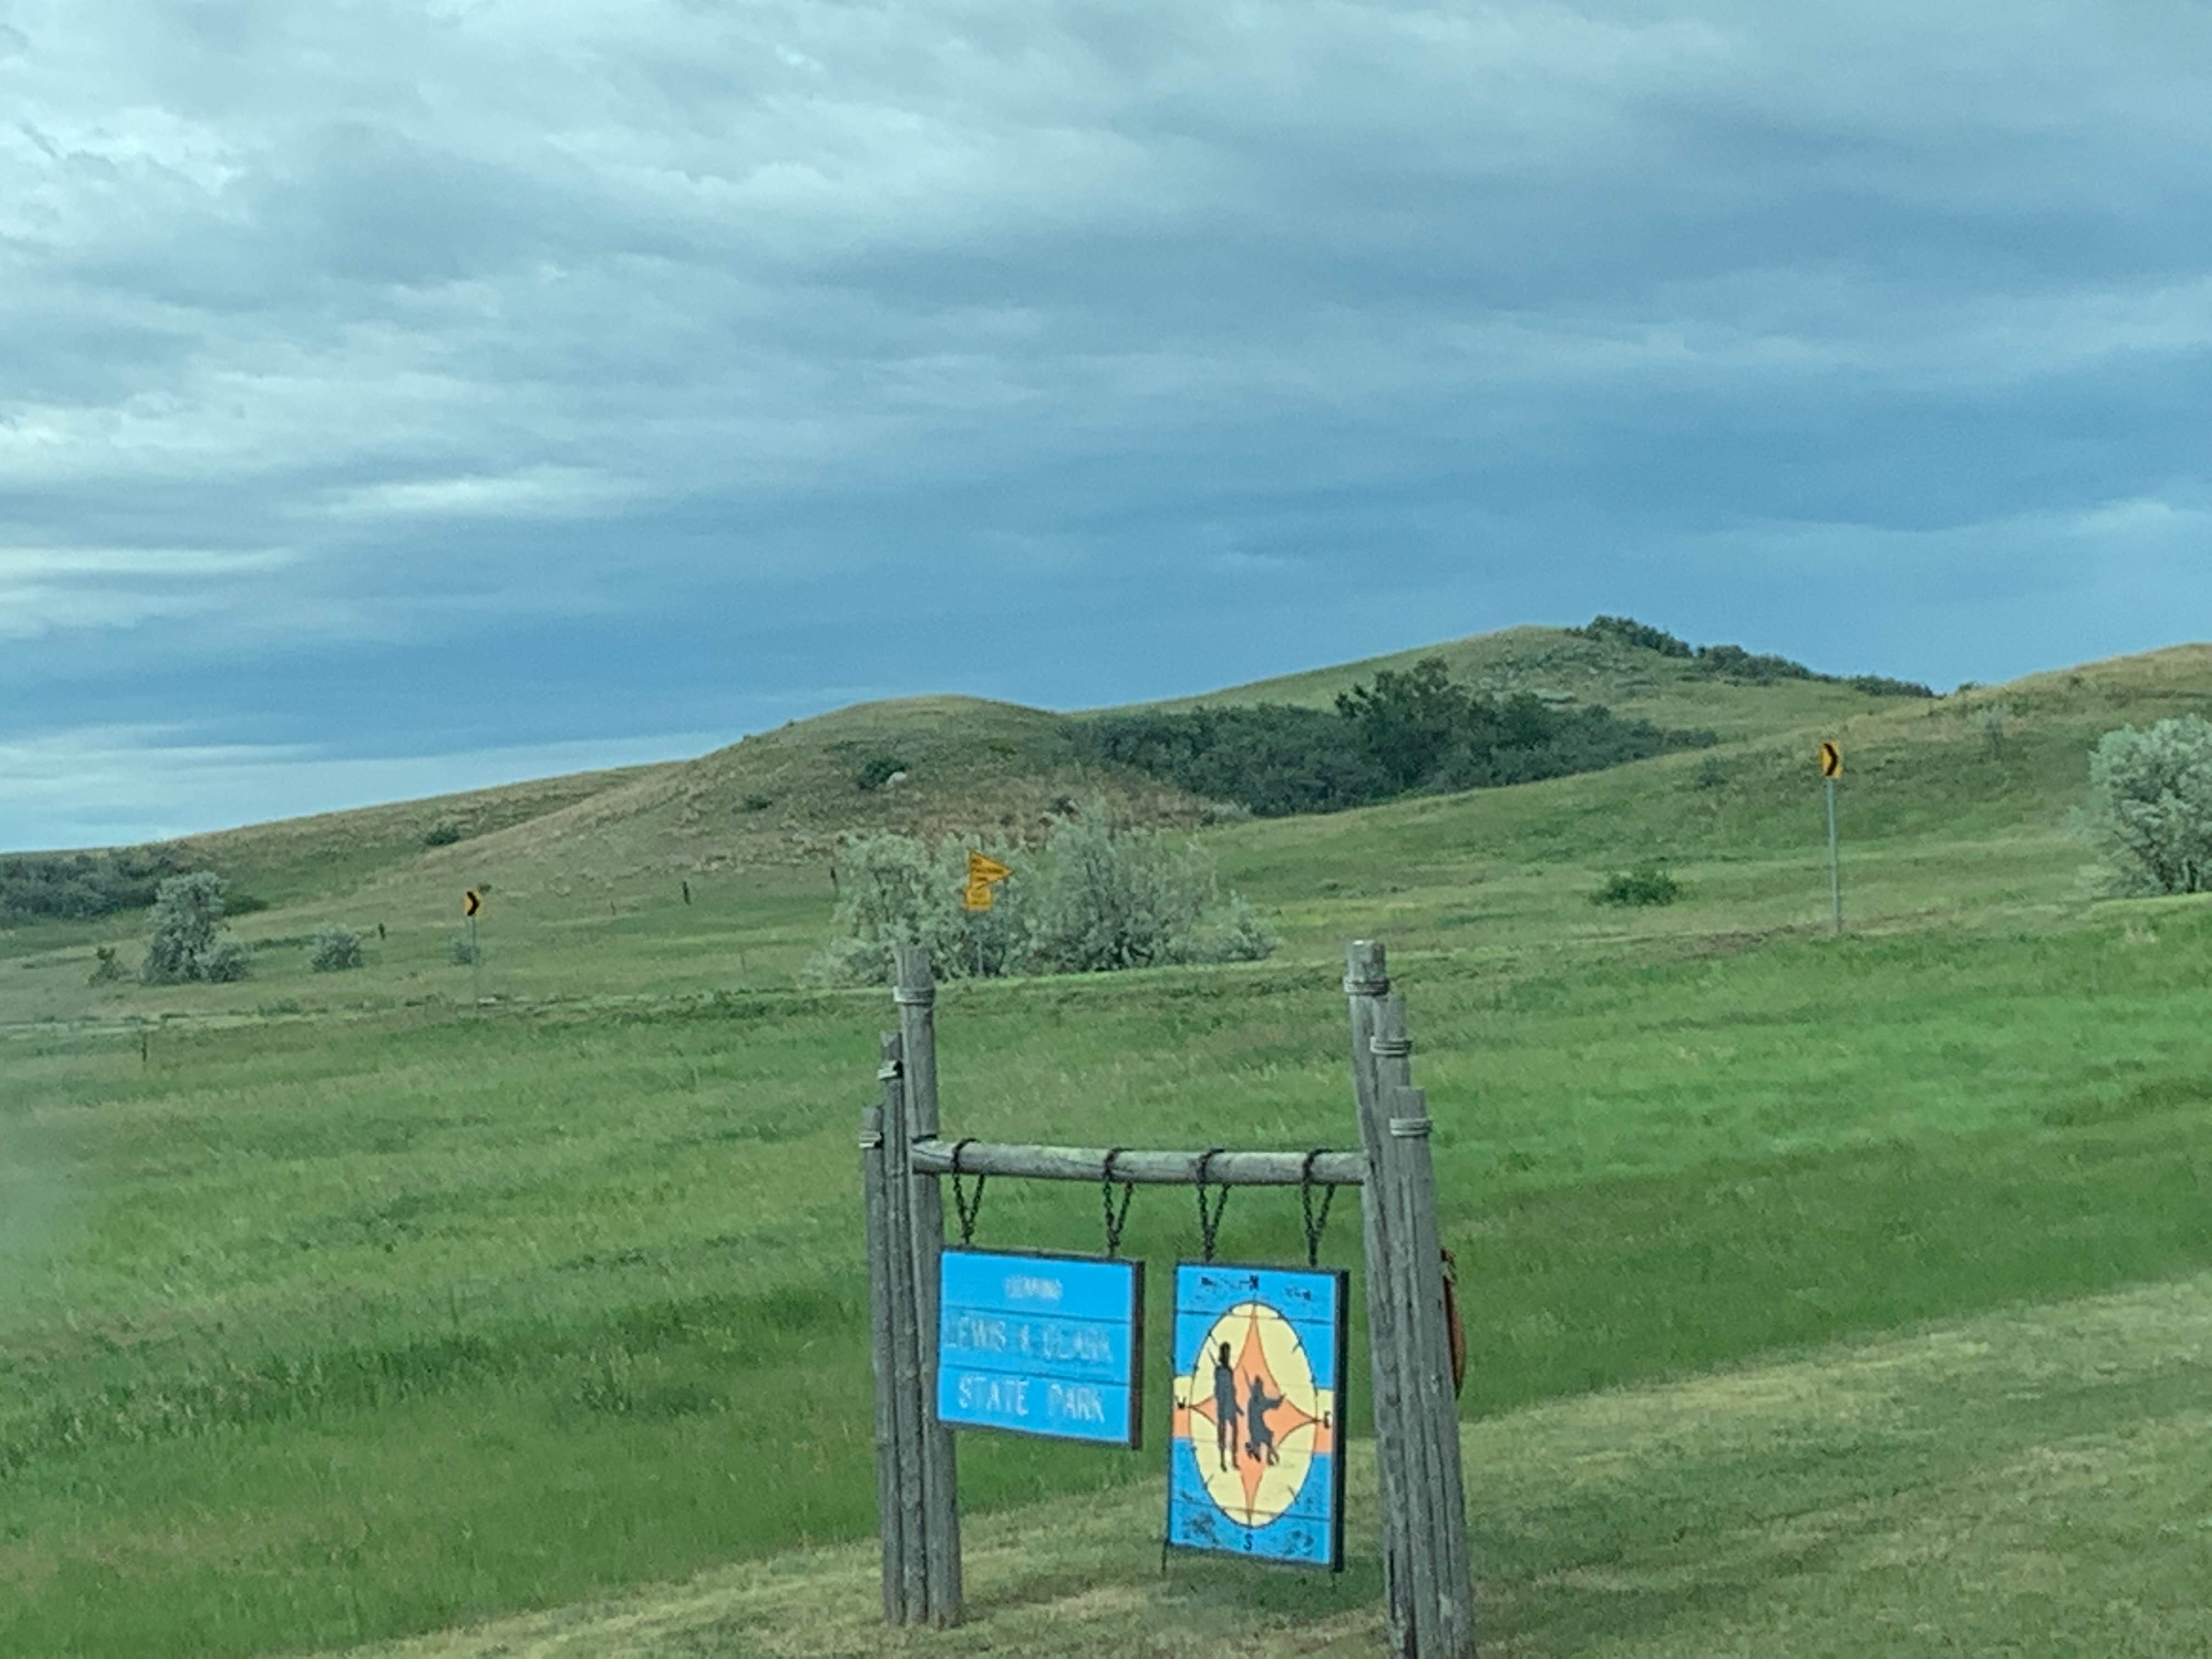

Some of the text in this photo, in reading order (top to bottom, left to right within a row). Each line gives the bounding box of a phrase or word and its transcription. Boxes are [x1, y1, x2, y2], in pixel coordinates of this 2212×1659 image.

[958, 1374, 1105, 1424] STATE PARK
[1243, 1533, 1254, 1551] S
